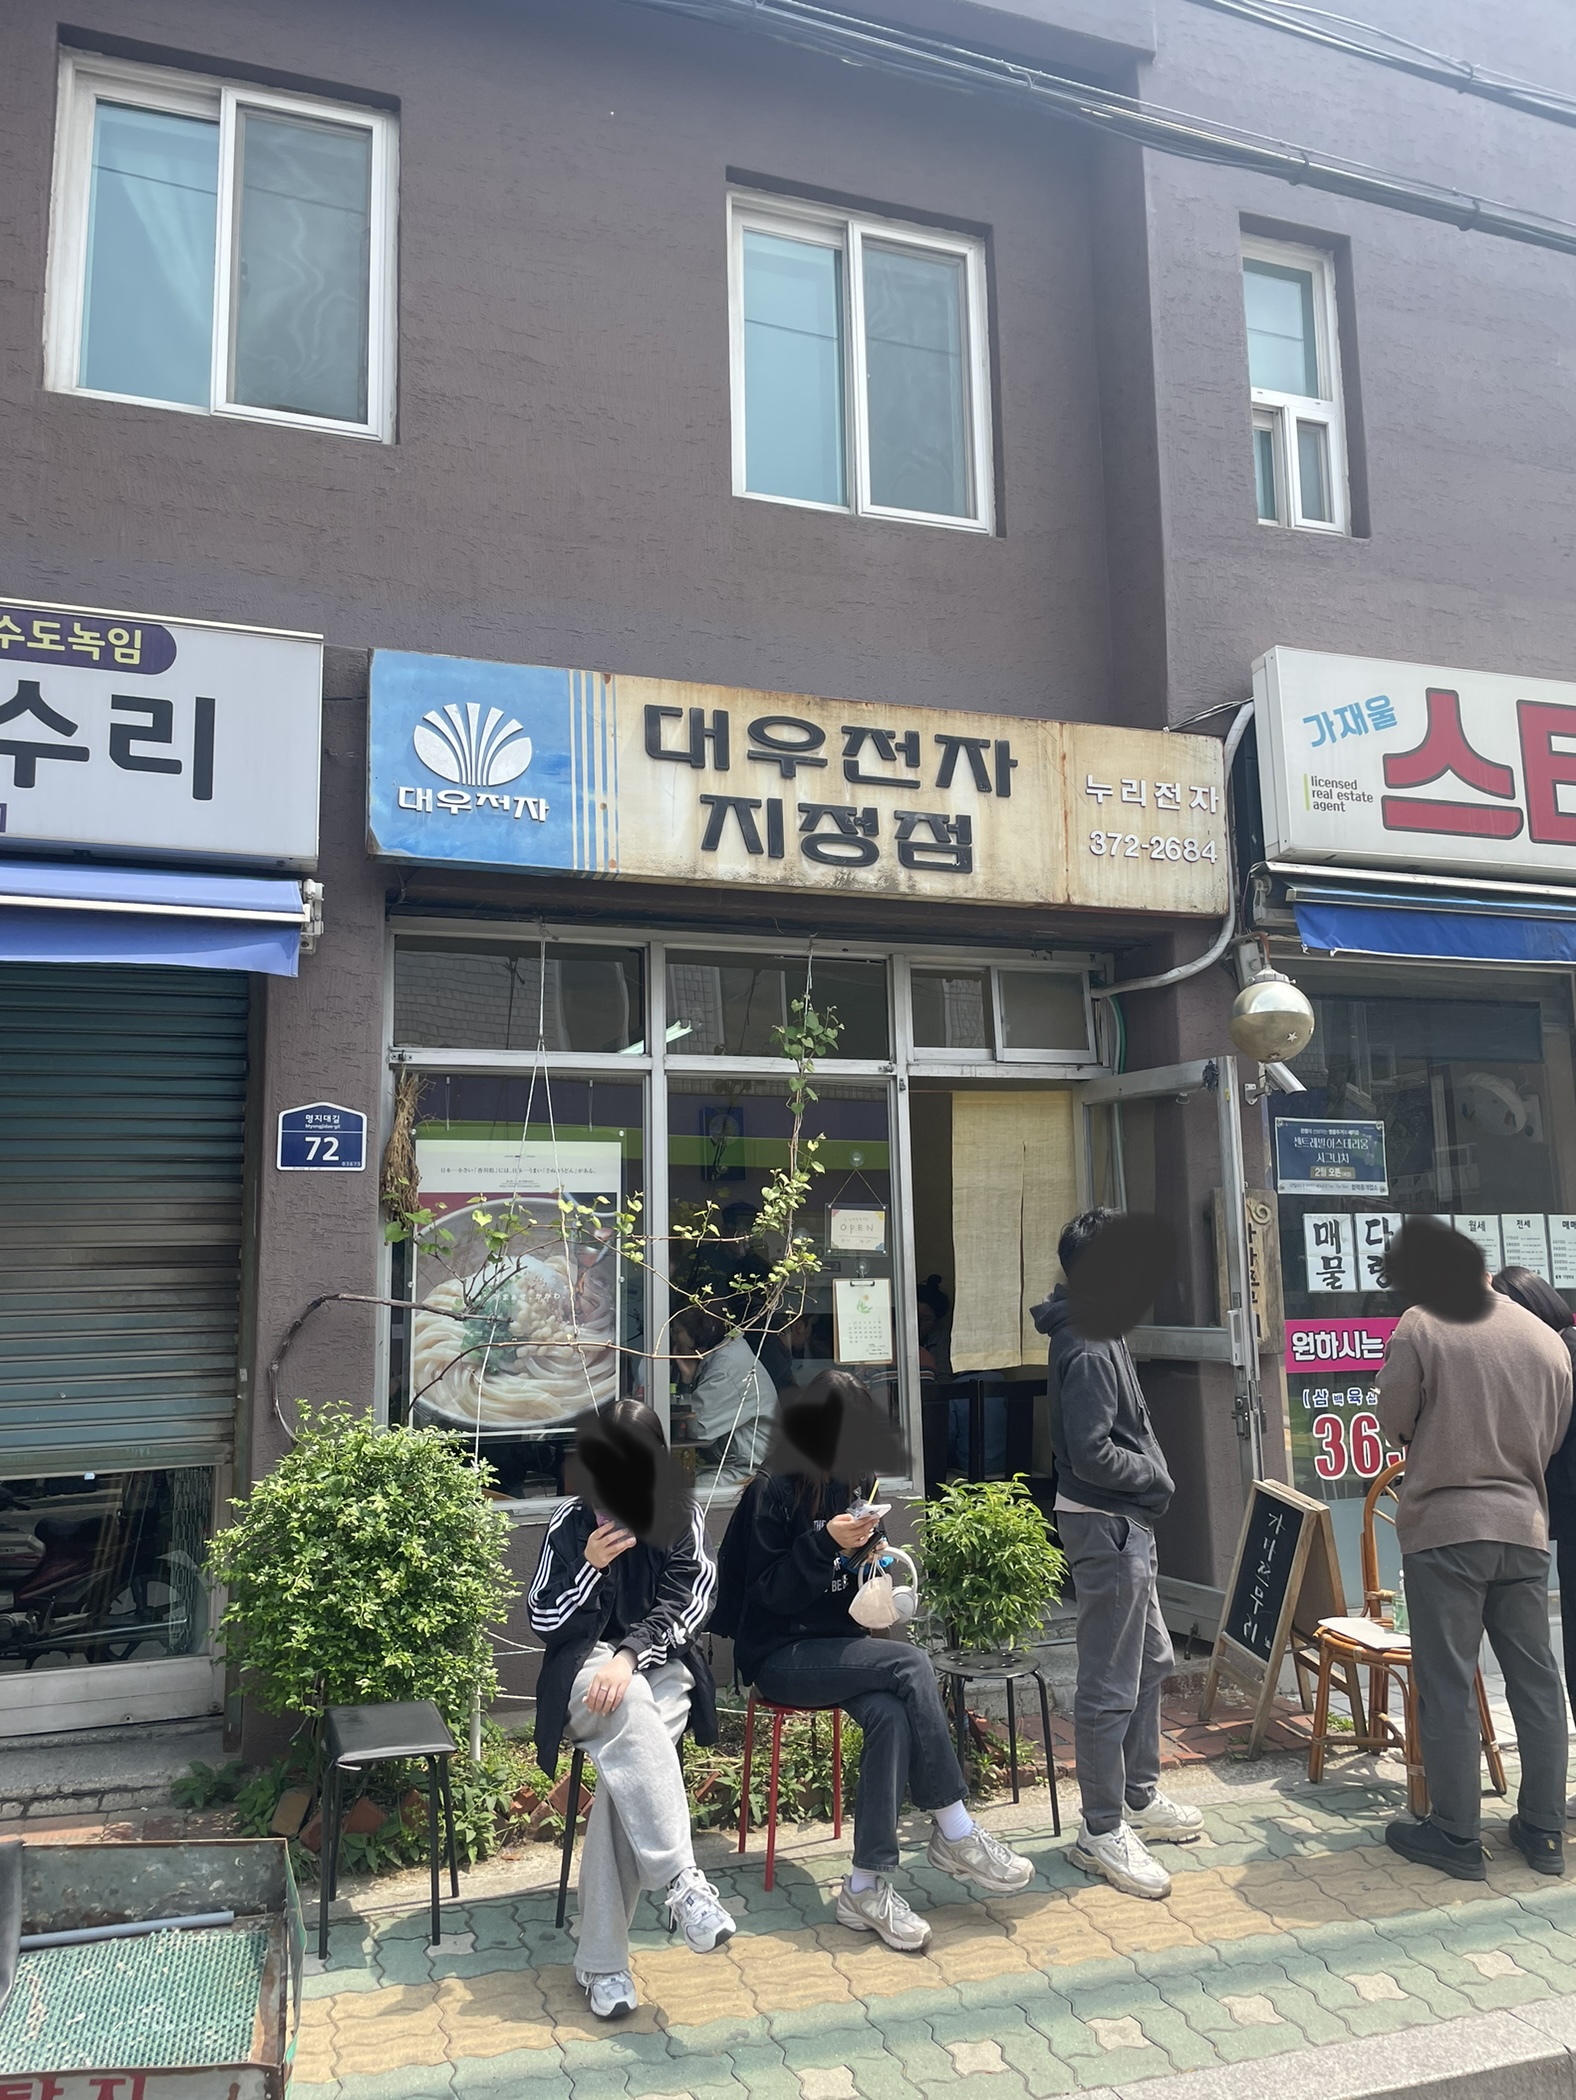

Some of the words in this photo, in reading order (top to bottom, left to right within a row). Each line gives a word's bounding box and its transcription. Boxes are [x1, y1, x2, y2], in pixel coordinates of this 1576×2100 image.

[1303, 695, 1398, 748] 가재울
[0, 679, 216, 801] 수리
[643, 703, 1018, 798] 대우전자
[1311, 775, 1358, 790] licensed
[1086, 774, 1219, 814] 누리전자
[1312, 789, 1333, 799] real
[1337, 791, 1374, 803] estate
[1313, 801, 1346, 812] agent
[699, 793, 973, 873] 지정점
[1089, 830, 1218, 864] 372-2684
[305, 1114, 340, 1124] 명지대길
[305, 1136, 340, 1161] 72
[1328, 1167, 1342, 1178] 오픈
[840, 1223, 874, 1234] OPEN
[1468, 1219, 1486, 1232] 월세
[1516, 1219, 1531, 1230] 전세
[1292, 1330, 1384, 1361] 원하시는
